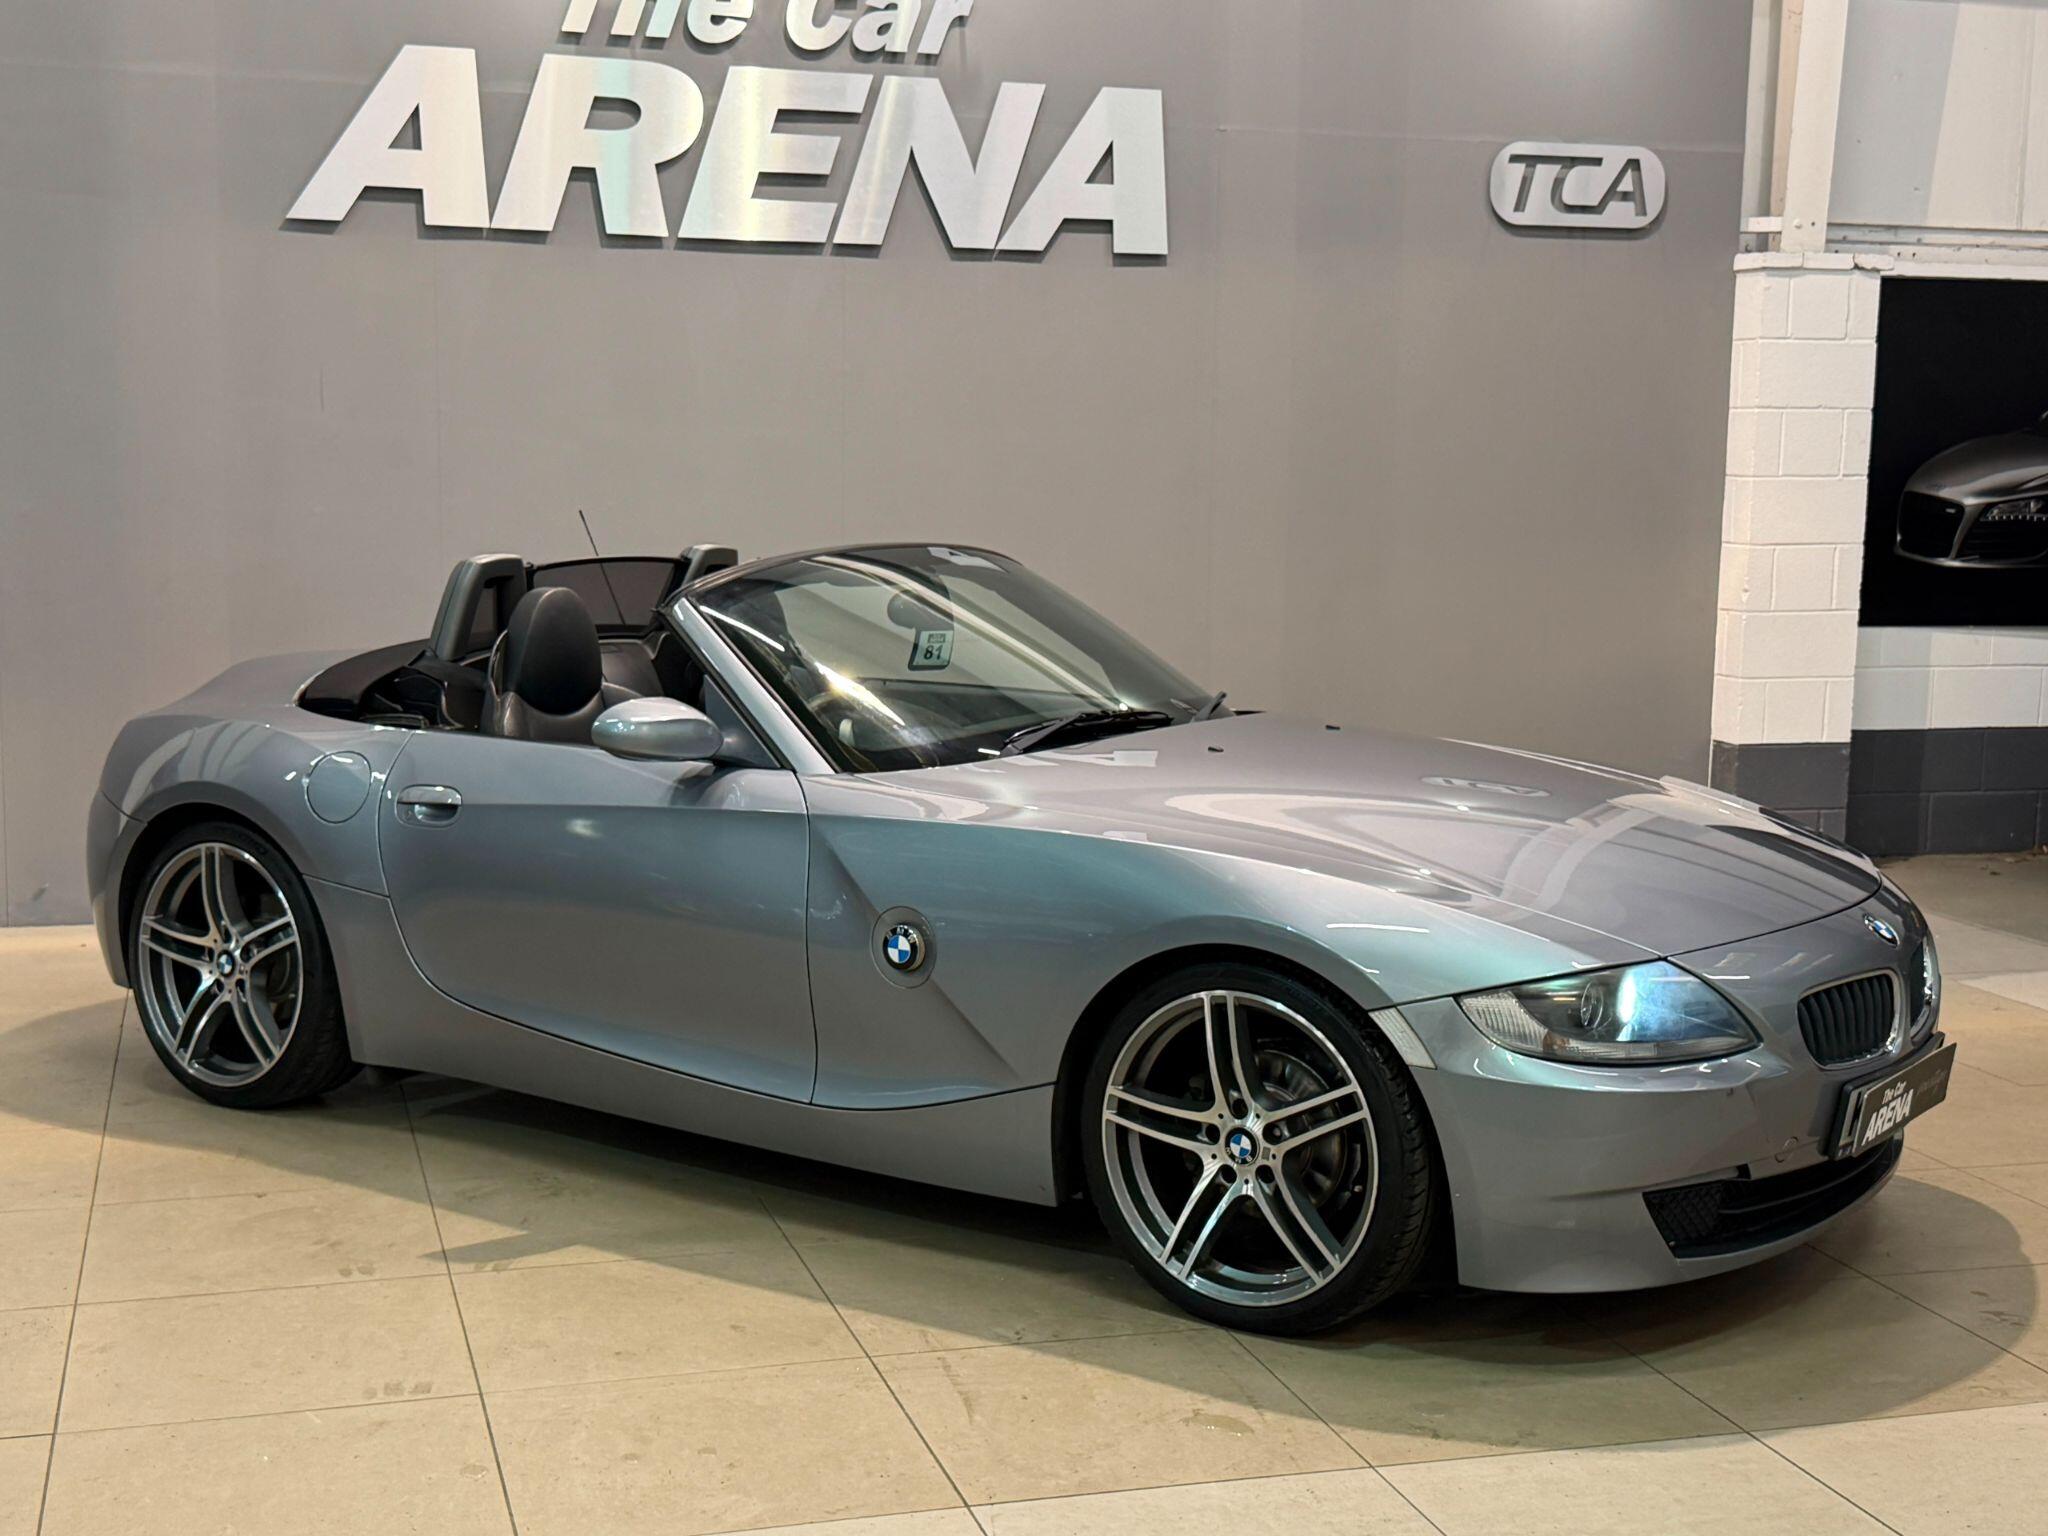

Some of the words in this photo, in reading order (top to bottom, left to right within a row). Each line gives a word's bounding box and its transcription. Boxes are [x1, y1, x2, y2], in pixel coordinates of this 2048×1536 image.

[786, 0, 975, 55] Car
[286, 44, 1168, 256] ARENA
[1508, 154, 1647, 217] TCA
[1861, 1088, 1914, 1146] ARENA
